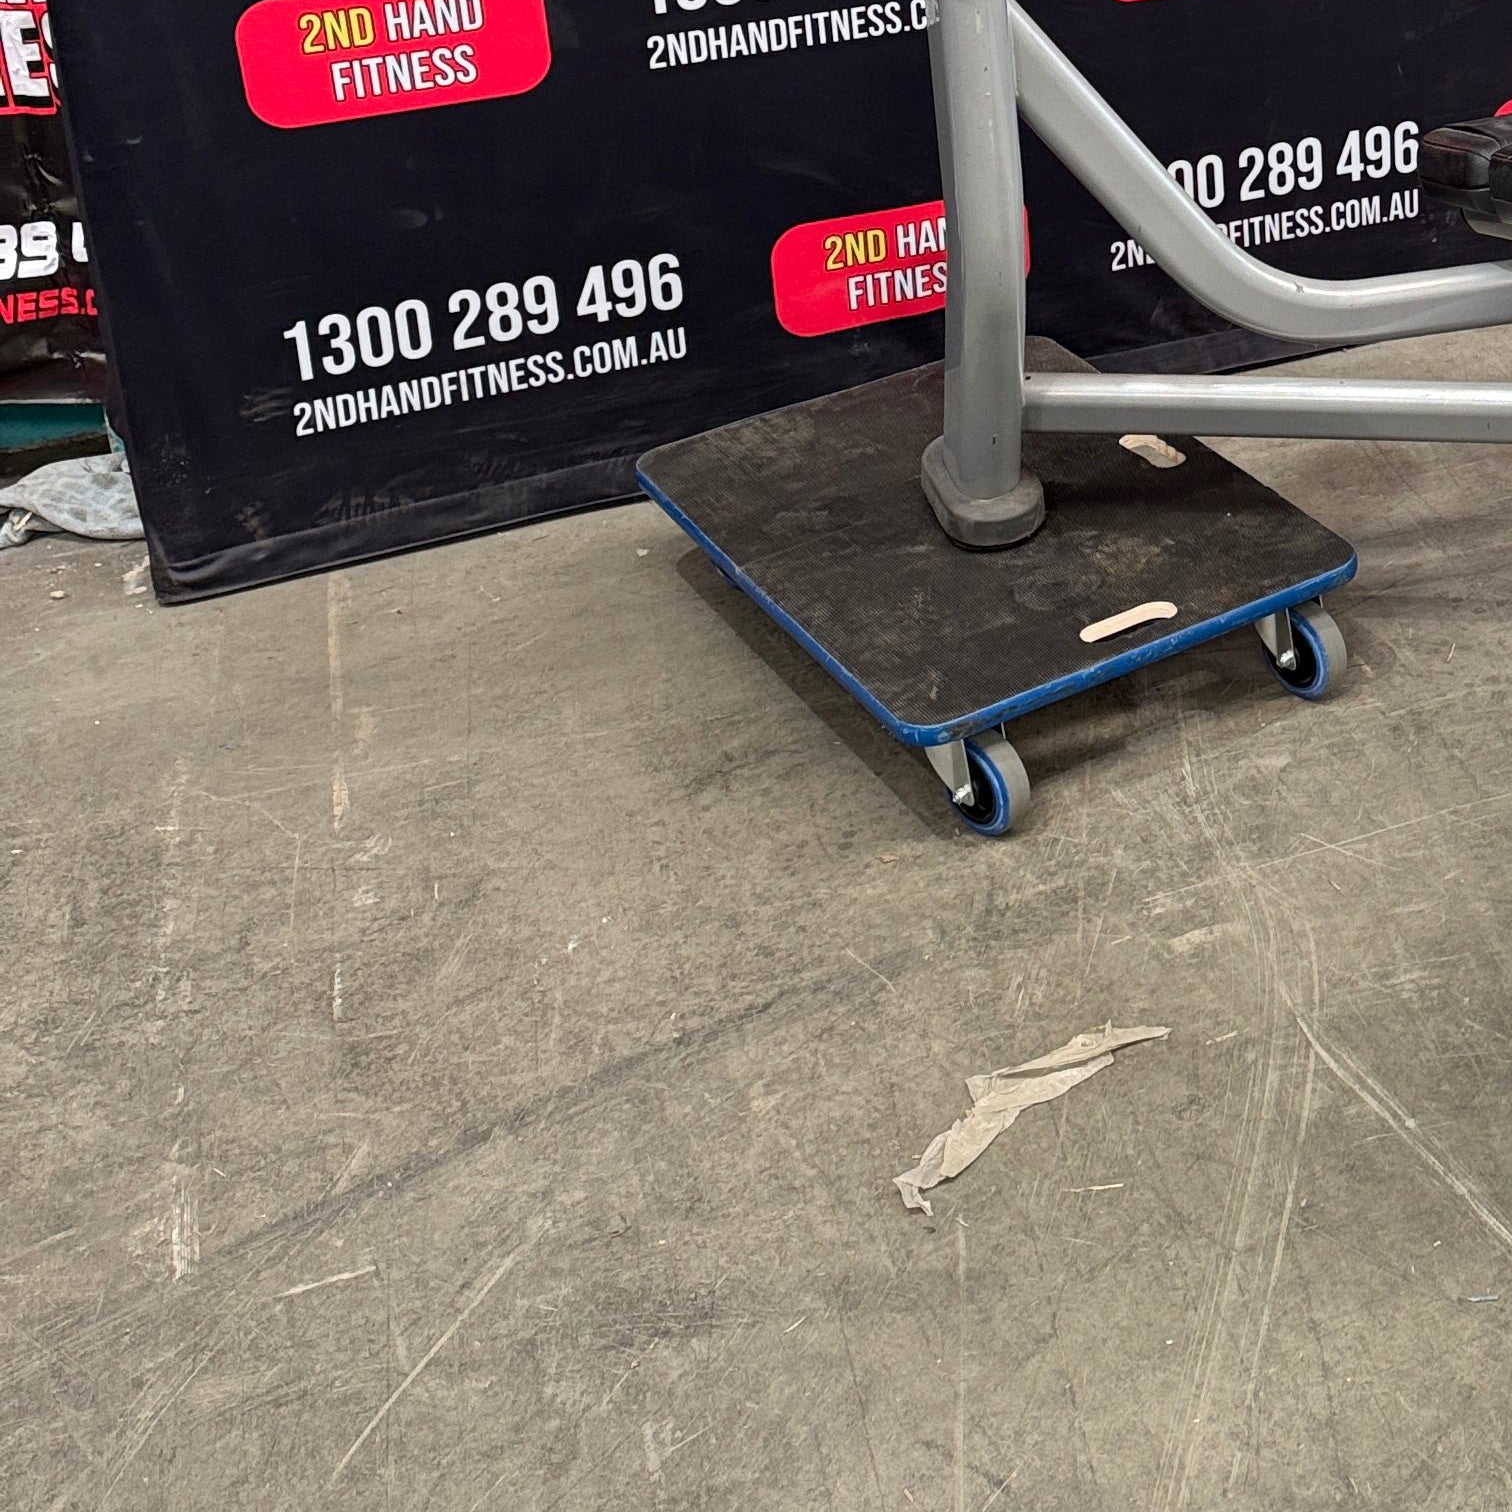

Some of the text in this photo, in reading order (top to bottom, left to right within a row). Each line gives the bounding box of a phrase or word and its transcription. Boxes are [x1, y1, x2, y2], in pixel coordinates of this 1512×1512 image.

[299, 7, 374, 54] 2ND
[331, 44, 477, 101] FITNESS
[1167, 120, 1419, 209] 00 289 496
[824, 229, 886, 270] 2ND
[1110, 188, 1420, 272] 2NFITNESS.COM.AU
[283, 253, 683, 381] 1300 289 496
[848, 261, 947, 311] FITNES
[293, 326, 688, 437] 2NDHANDFITNESS.COM.AU
